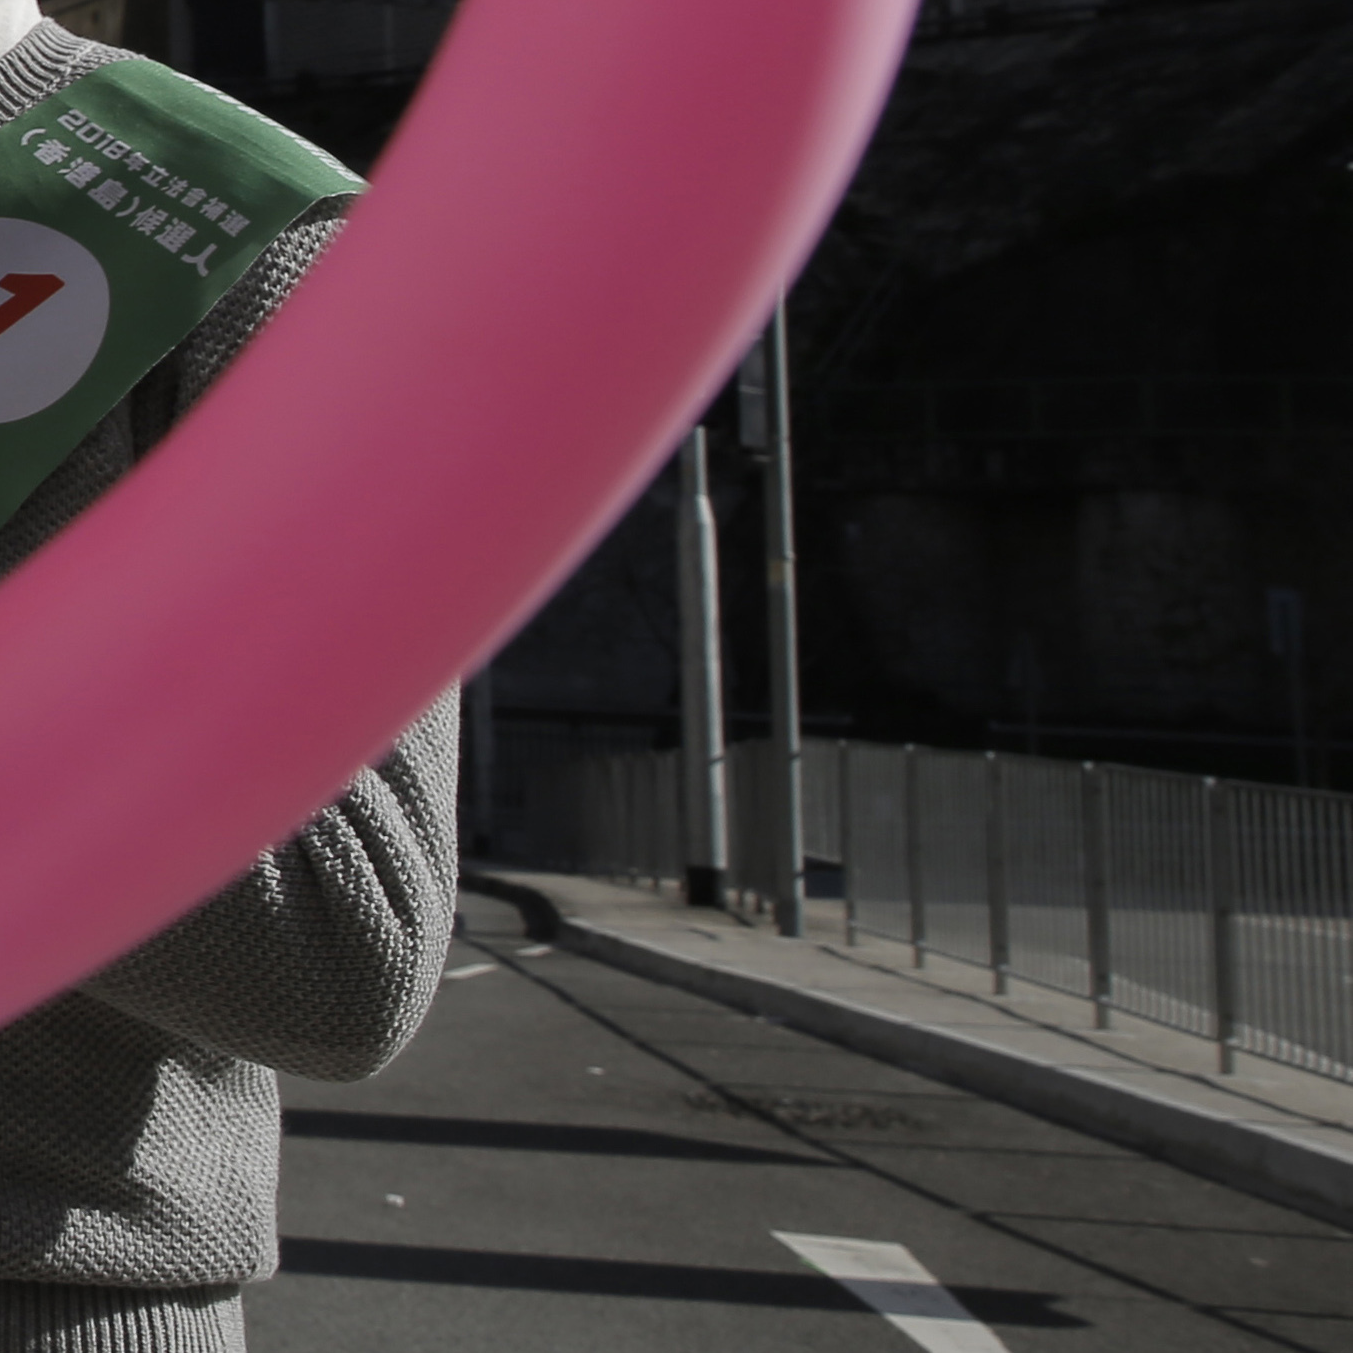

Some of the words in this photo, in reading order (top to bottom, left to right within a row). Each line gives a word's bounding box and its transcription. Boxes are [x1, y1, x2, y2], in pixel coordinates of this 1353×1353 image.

[57, 109, 250, 238] 2018年立法會補選
